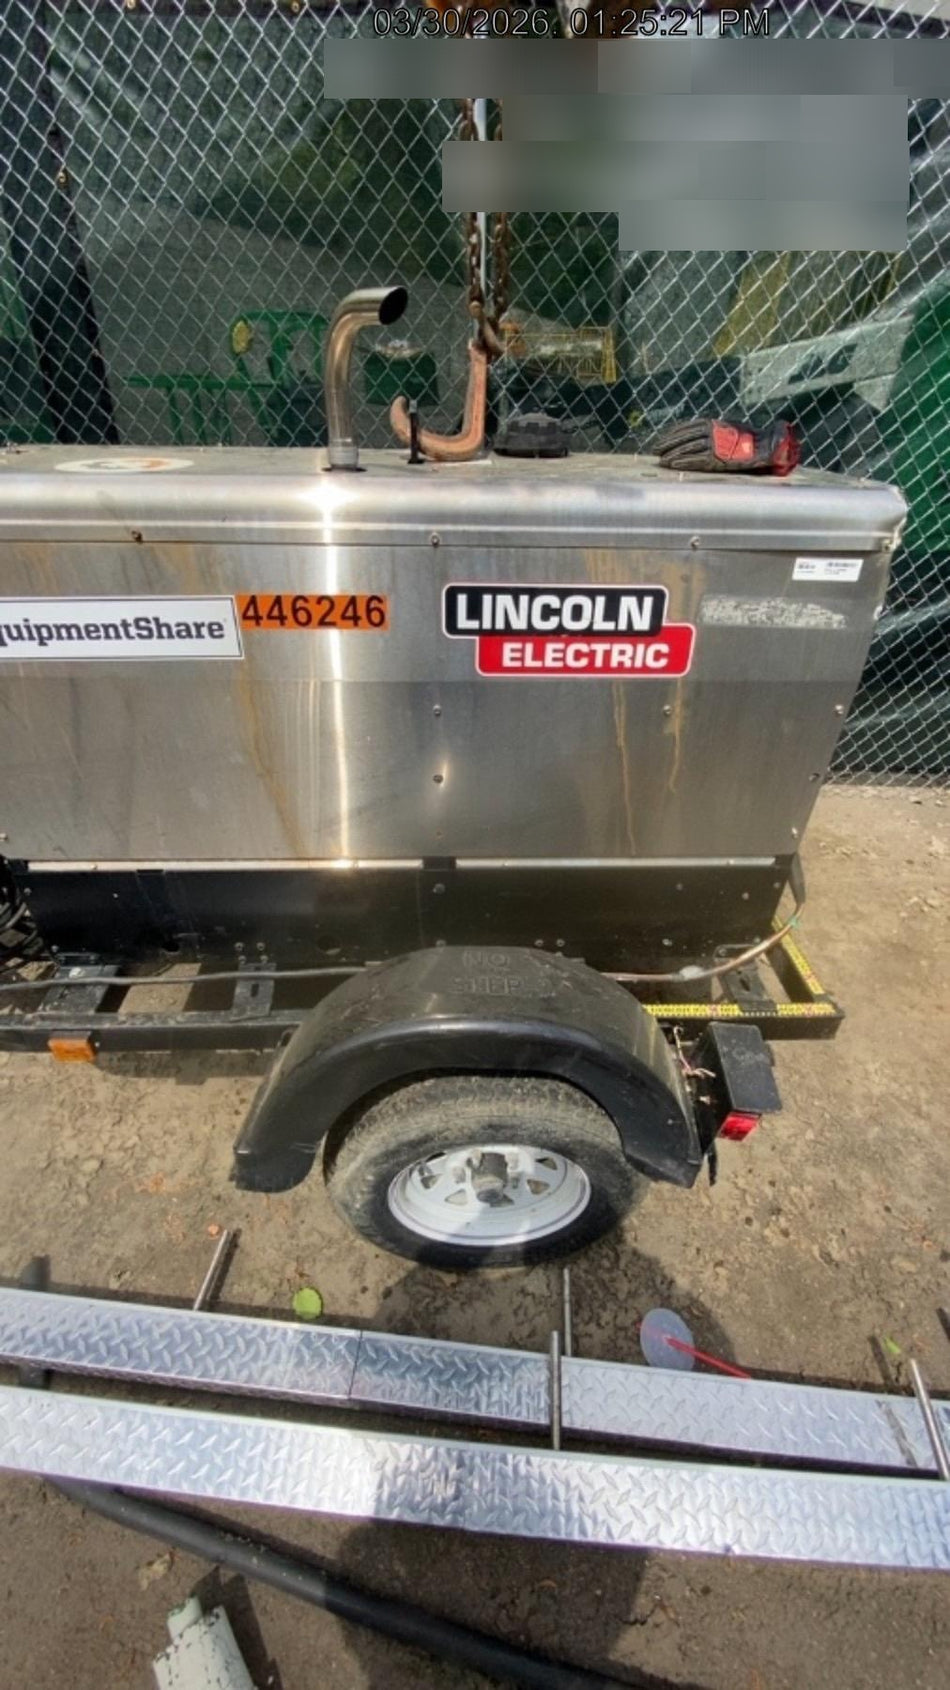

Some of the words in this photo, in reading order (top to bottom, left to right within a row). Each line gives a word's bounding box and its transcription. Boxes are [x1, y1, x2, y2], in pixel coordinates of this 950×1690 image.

[241, 594, 386, 628] 446246
[456, 593, 654, 631] LINCOLN
[502, 642, 670, 668] ELECTRIC
